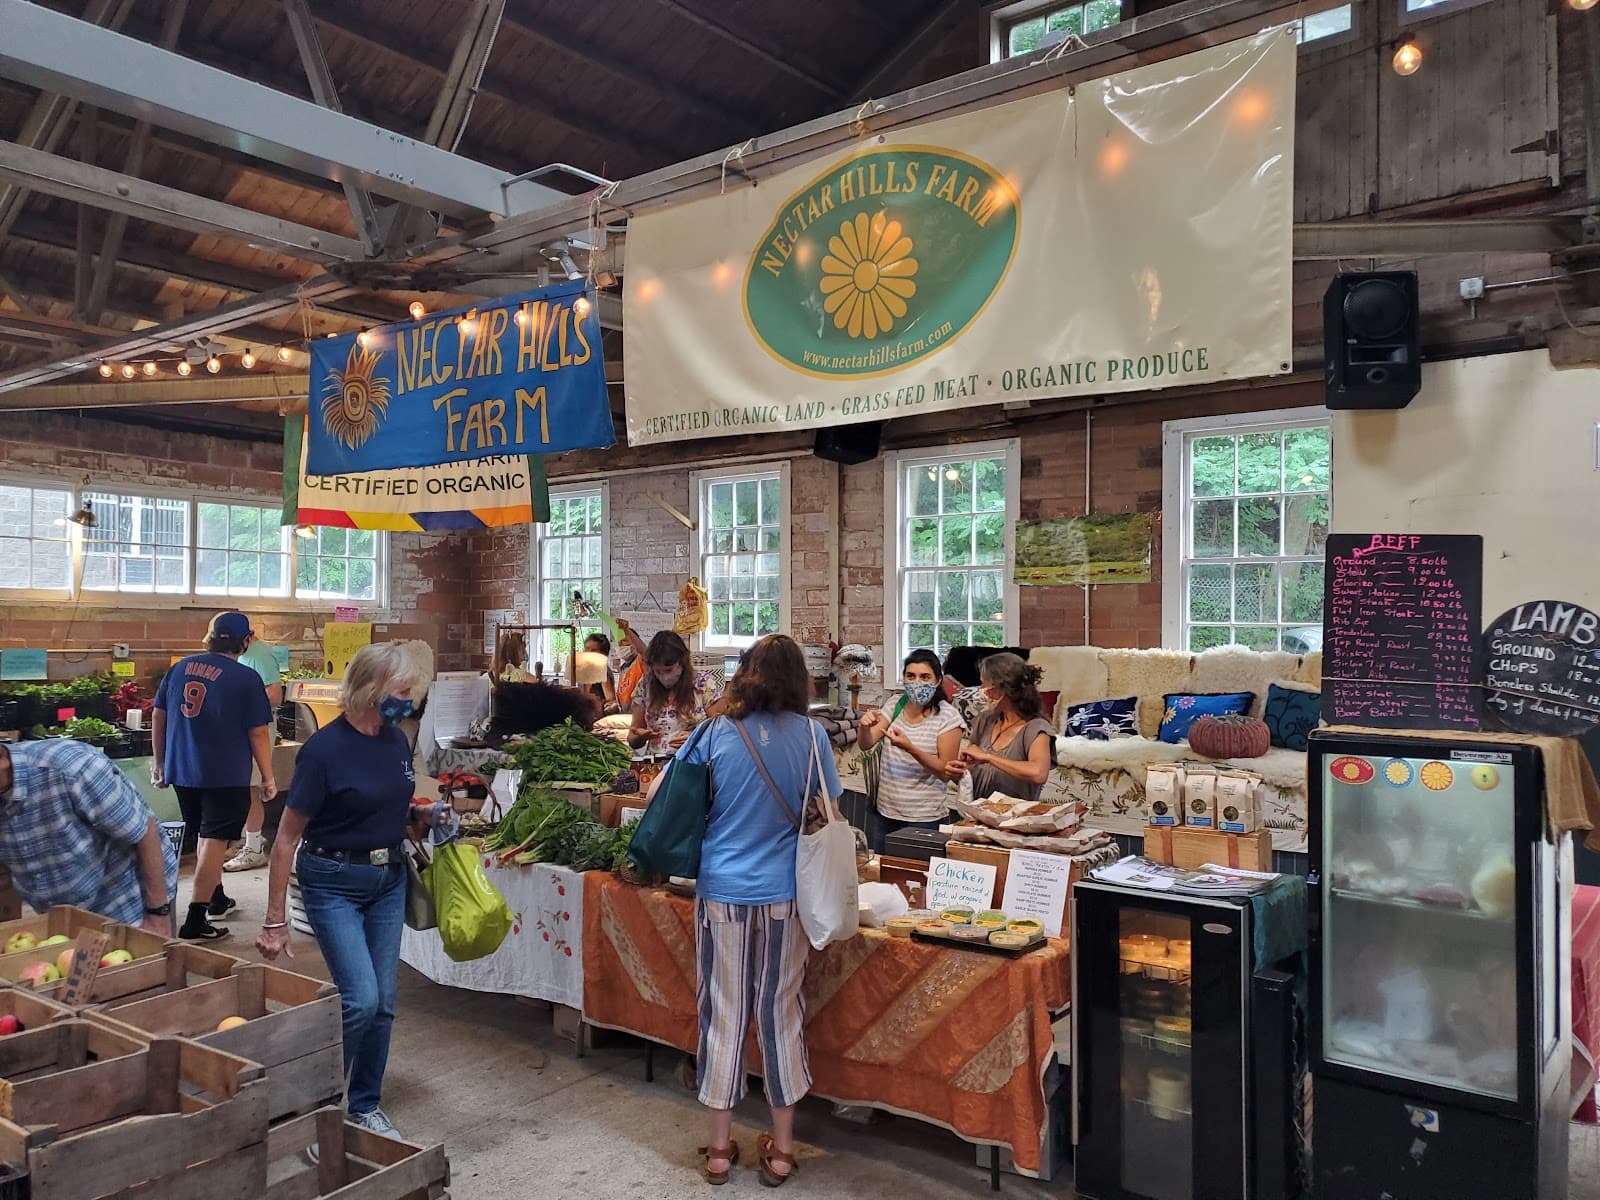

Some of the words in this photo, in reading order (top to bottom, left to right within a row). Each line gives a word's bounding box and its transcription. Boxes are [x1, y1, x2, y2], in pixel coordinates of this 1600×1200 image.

[761, 184, 834, 277] NECTAR
[840, 160, 920, 204] HILLS
[925, 164, 994, 228] FARM
[396, 308, 508, 396] NECTAR
[516, 300, 592, 372] HILLS
[803, 321, 952, 368] www.nectarhillsfarm.com
[646, 411, 710, 436] CERTIFIED
[714, 406, 778, 427] ORGANIC
[784, 402, 825, 422] LAND
[842, 392, 889, 416] GRASS
[896, 384, 926, 407] FED
[933, 374, 979, 402] MEAT
[1002, 361, 1097, 391] ORGANIC
[1107, 348, 1209, 381] PRODUCE
[433, 386, 550, 453] FARM
[426, 473, 524, 494] ORGANIC
[1370, 534, 1420, 549] BEEF
[1333, 556, 1376, 567] Ground
[1511, 602, 1598, 644] LAMB
[1492, 640, 1555, 661] GROUND
[181, 681, 207, 718] 9
[1487, 674, 1534, 691] Boneless
[935, 863, 984, 884] Chicken
